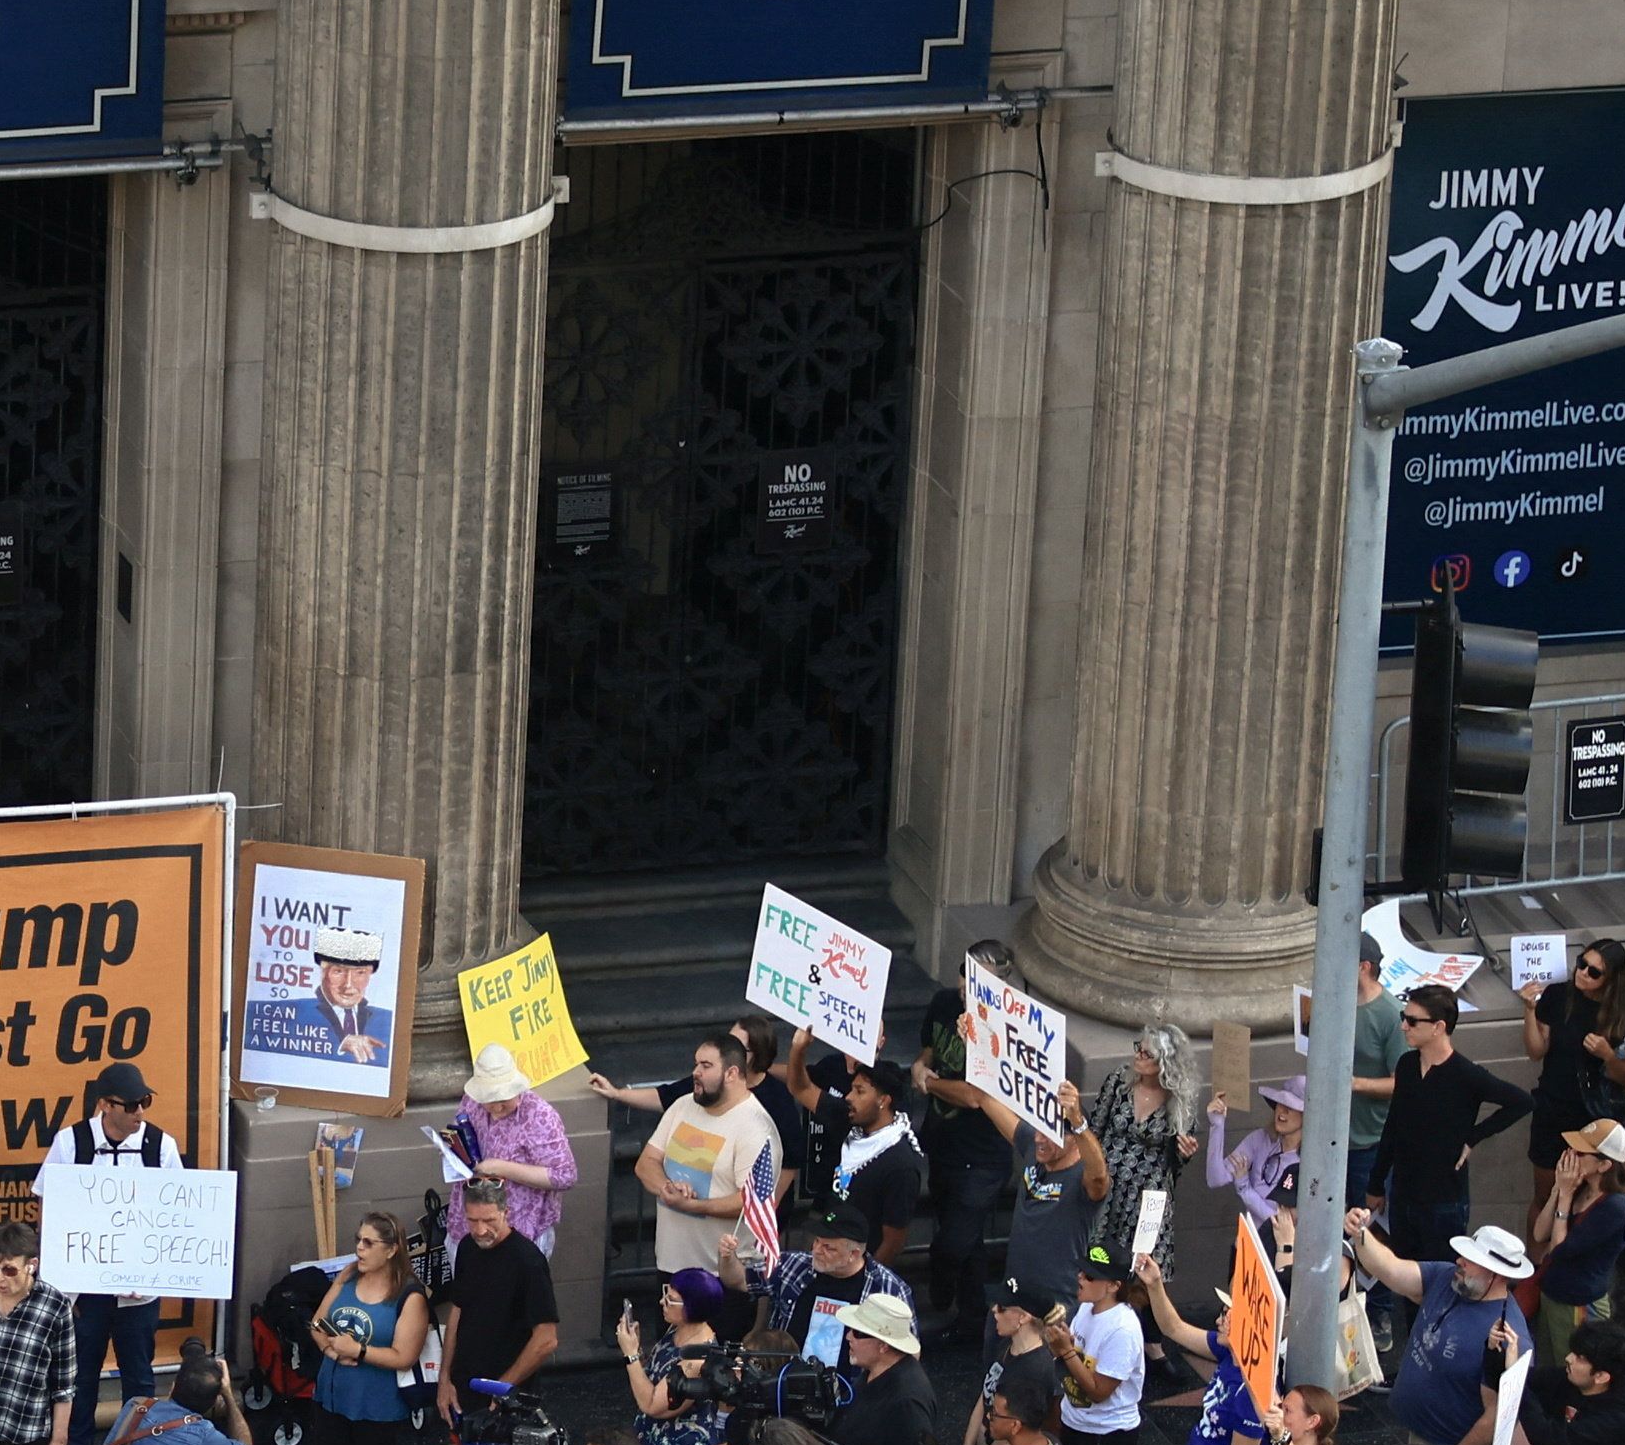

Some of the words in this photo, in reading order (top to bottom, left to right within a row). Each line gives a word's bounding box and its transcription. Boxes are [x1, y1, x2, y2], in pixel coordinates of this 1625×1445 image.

[1429, 166, 1544, 210] JIMMY
[1424, 486, 1604, 529] @JimmyKimmel
[260, 896, 267, 918] I
[274, 896, 352, 927] WANT
[764, 903, 818, 952] FREE
[260, 924, 310, 950] YOU
[827, 933, 866, 961] JIMMY
[273, 950, 294, 962] TO
[255, 962, 314, 989] LOSE
[755, 961, 812, 1017] FREE
[970, 962, 1001, 1011] HANDS
[270, 986, 289, 999] SO
[818, 990, 866, 1025] SPEECH
[56, 993, 151, 1063] Go
[263, 1004, 296, 1019] CAN
[251, 1035, 261, 1046] A
[266, 1036, 333, 1054] WINNER
[253, 1018, 290, 1035] FEEL
[296, 1023, 328, 1040] LIKE
[837, 1019, 867, 1046] ALL
[1004, 1022, 1051, 1081] FREE
[998, 1061, 1064, 1138] SPEECH
[79, 1175, 136, 1205] YOU
[110, 1210, 195, 1228] CANCEL
[67, 1231, 126, 1264] FREE
[142, 1235, 229, 1266] SPEECH!
[1242, 1261, 1270, 1351] WAKE
[1241, 1318, 1260, 1381] UP
